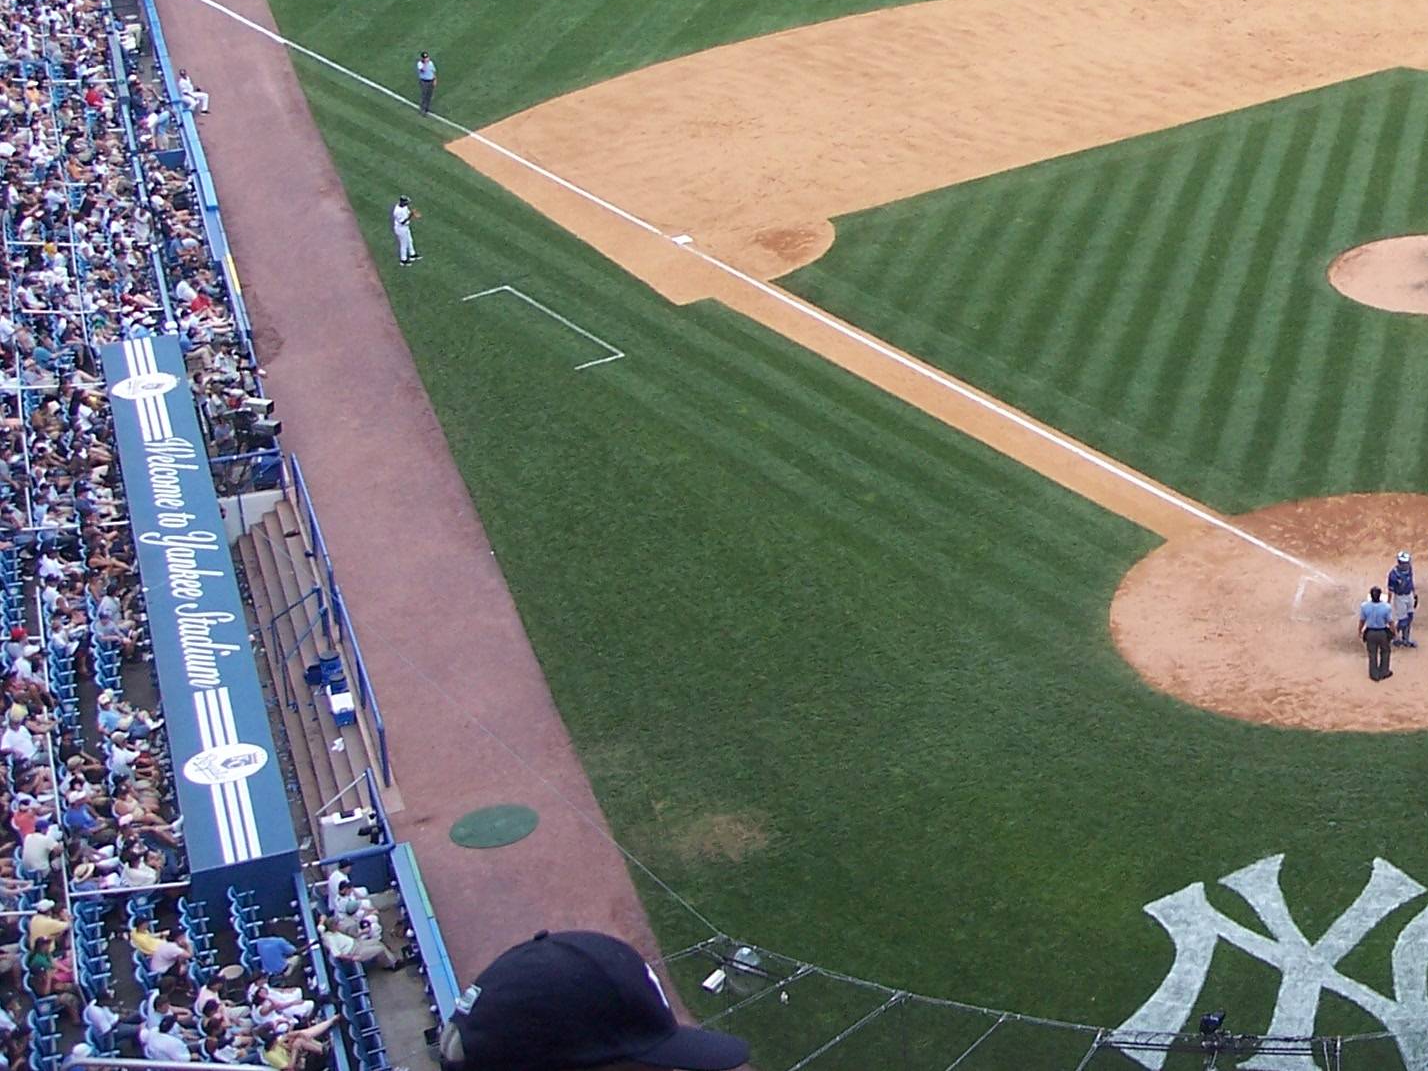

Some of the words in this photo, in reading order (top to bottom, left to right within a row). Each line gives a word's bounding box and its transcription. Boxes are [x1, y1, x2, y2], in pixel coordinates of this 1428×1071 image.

[144, 437, 199, 509] Welcome
[157, 510, 196, 529] to
[139, 530, 225, 599] Yankee
[174, 602, 241, 690] Stadium
